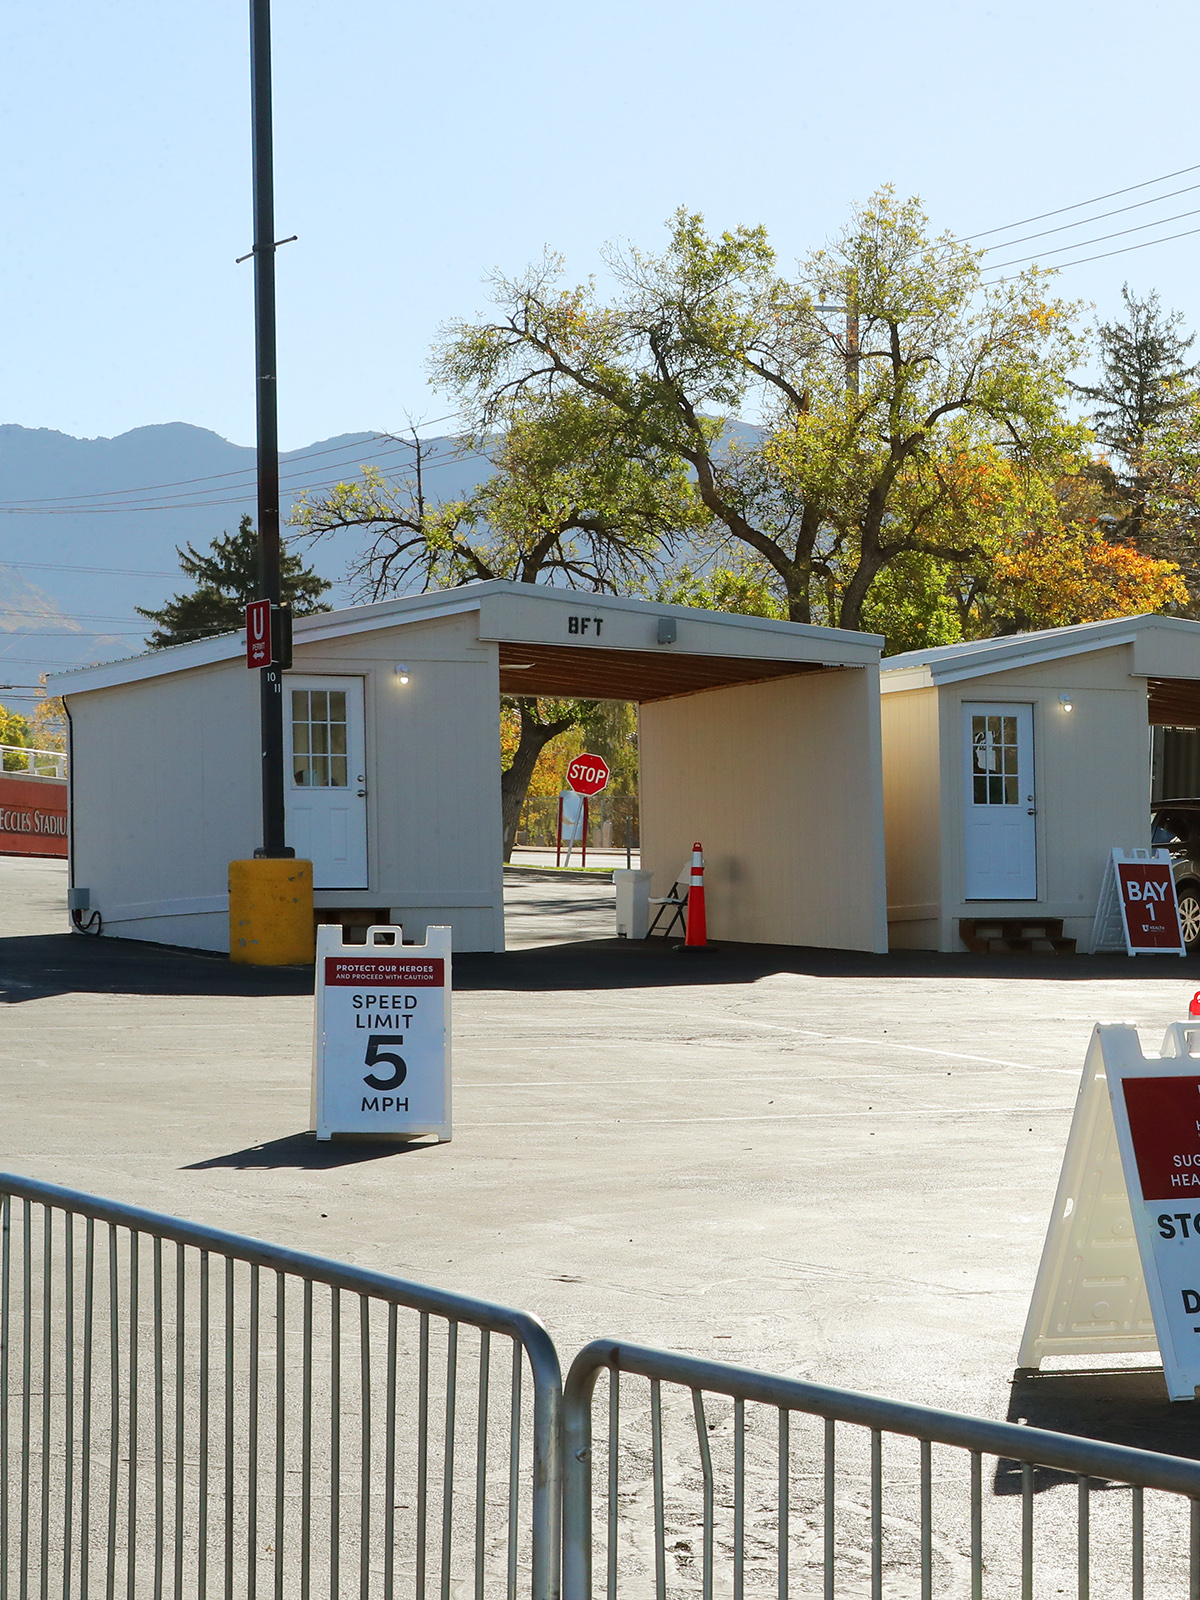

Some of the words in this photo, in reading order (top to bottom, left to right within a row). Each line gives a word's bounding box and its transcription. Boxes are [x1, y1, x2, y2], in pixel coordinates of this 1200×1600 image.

[253, 607, 264, 640] U
[267, 672, 276, 682] 10
[274, 683, 281, 693] 11
[569, 763, 606, 784] STOP
[1126, 881, 1169, 901] BAY
[1145, 902, 1156, 921] 1
[336, 964, 376, 972] PROTECT
[399, 965, 434, 973] HEROES
[352, 994, 418, 1010] SPEED
[356, 1014, 414, 1029] LIMIT
[363, 1034, 407, 1091] 5
[361, 1097, 409, 1112] MPH
